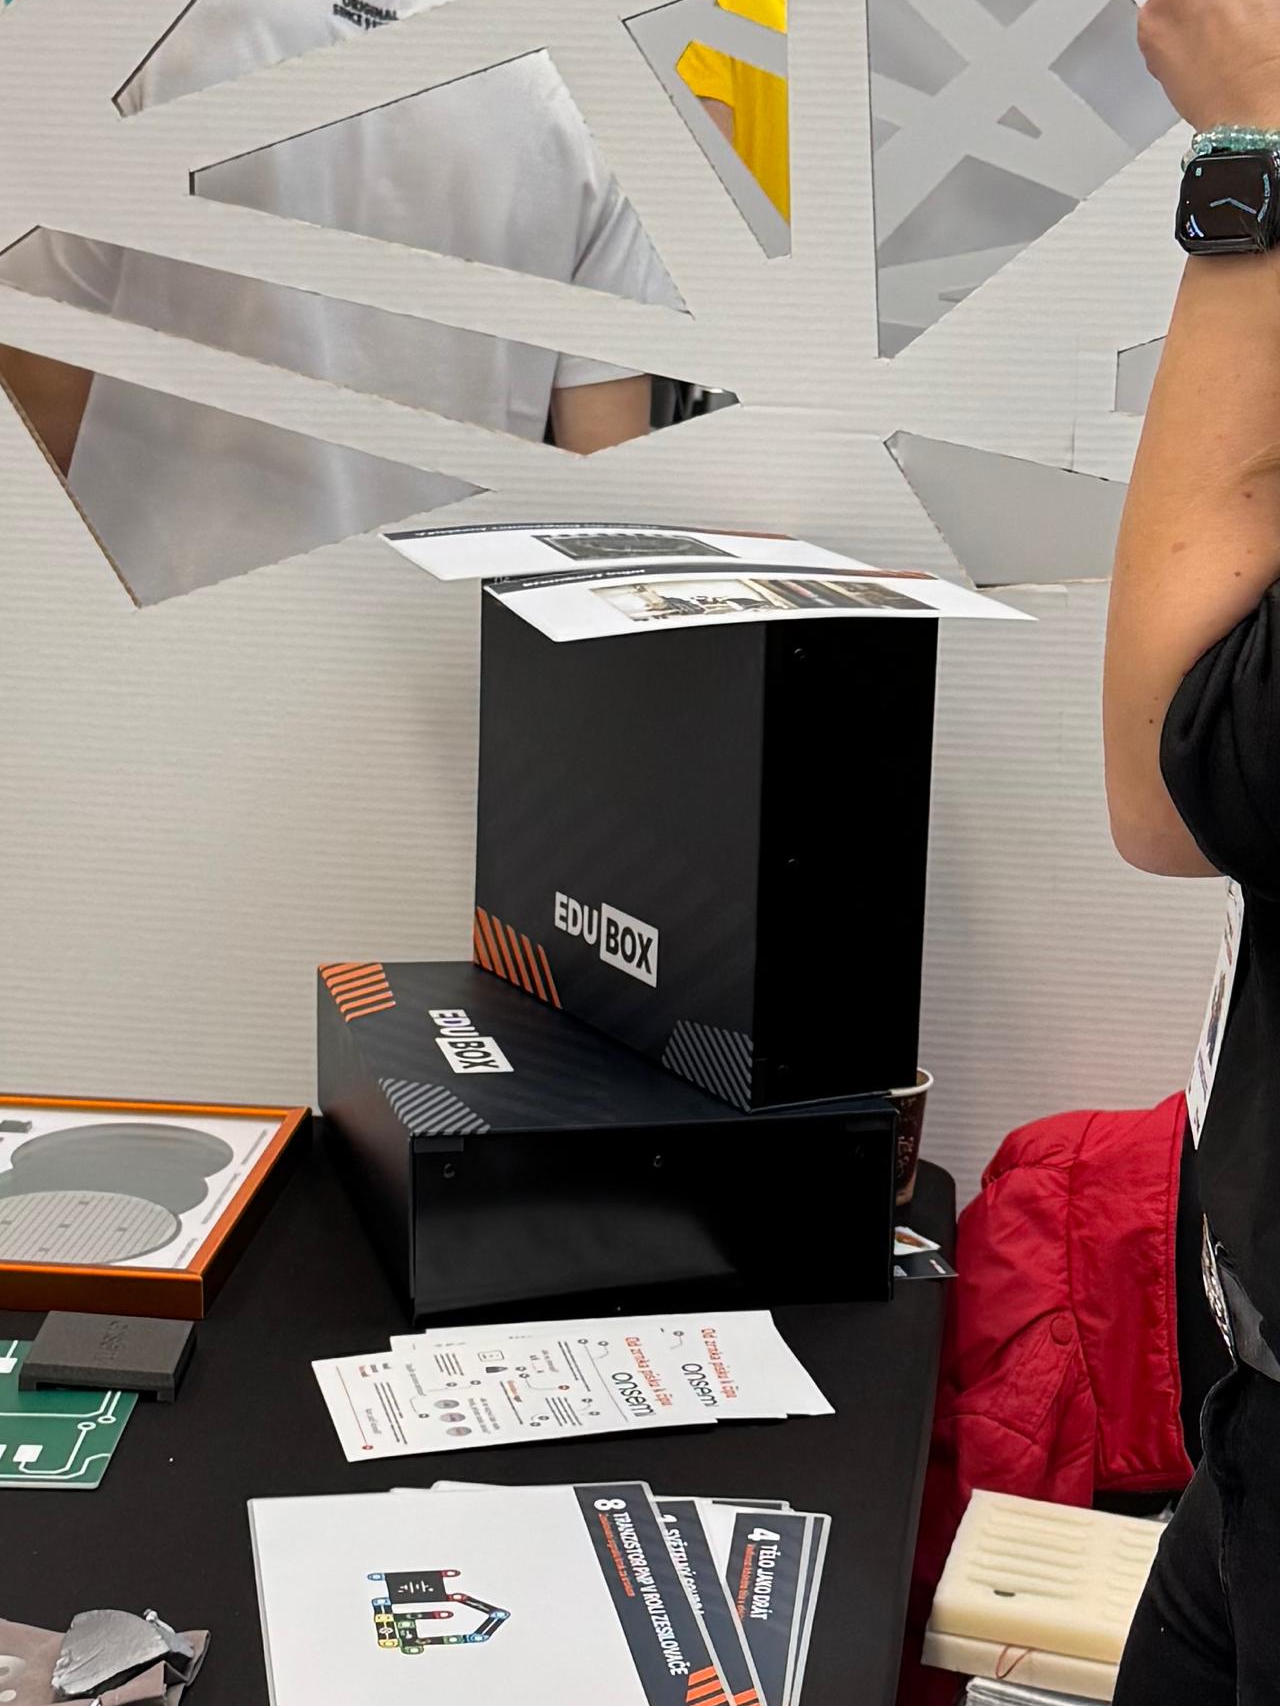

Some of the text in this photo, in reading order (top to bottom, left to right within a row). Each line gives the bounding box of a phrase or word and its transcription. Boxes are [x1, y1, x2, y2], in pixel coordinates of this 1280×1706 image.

[554, 891, 653, 975] EDU BOX
[428, 1009, 479, 1037] EDU
[594, 1499, 626, 1510] 8
[747, 1527, 781, 1541] 4
